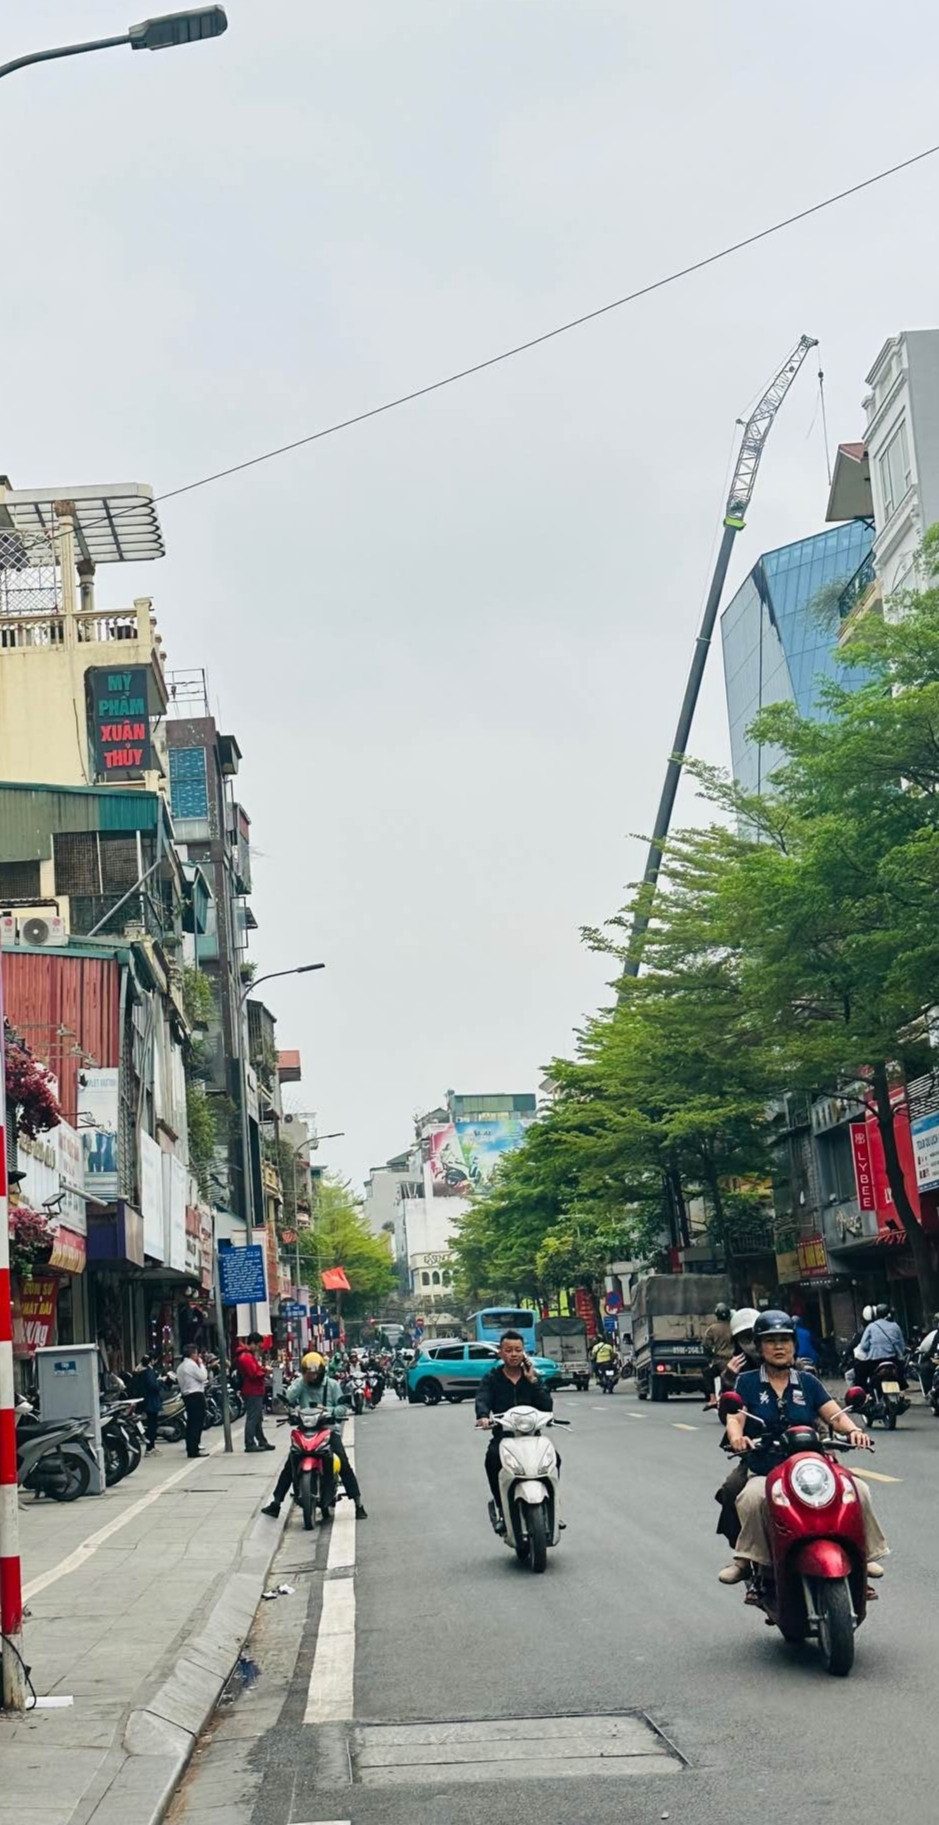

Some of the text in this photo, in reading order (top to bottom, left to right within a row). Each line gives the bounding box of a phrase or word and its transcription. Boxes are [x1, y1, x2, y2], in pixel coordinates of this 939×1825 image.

[107, 671, 132, 691] MỸ
[98, 691, 146, 717] PHẨM
[100, 720, 146, 742] XUÂN
[103, 743, 143, 769] THỦY
[857, 1151, 872, 1207] LYBEE
